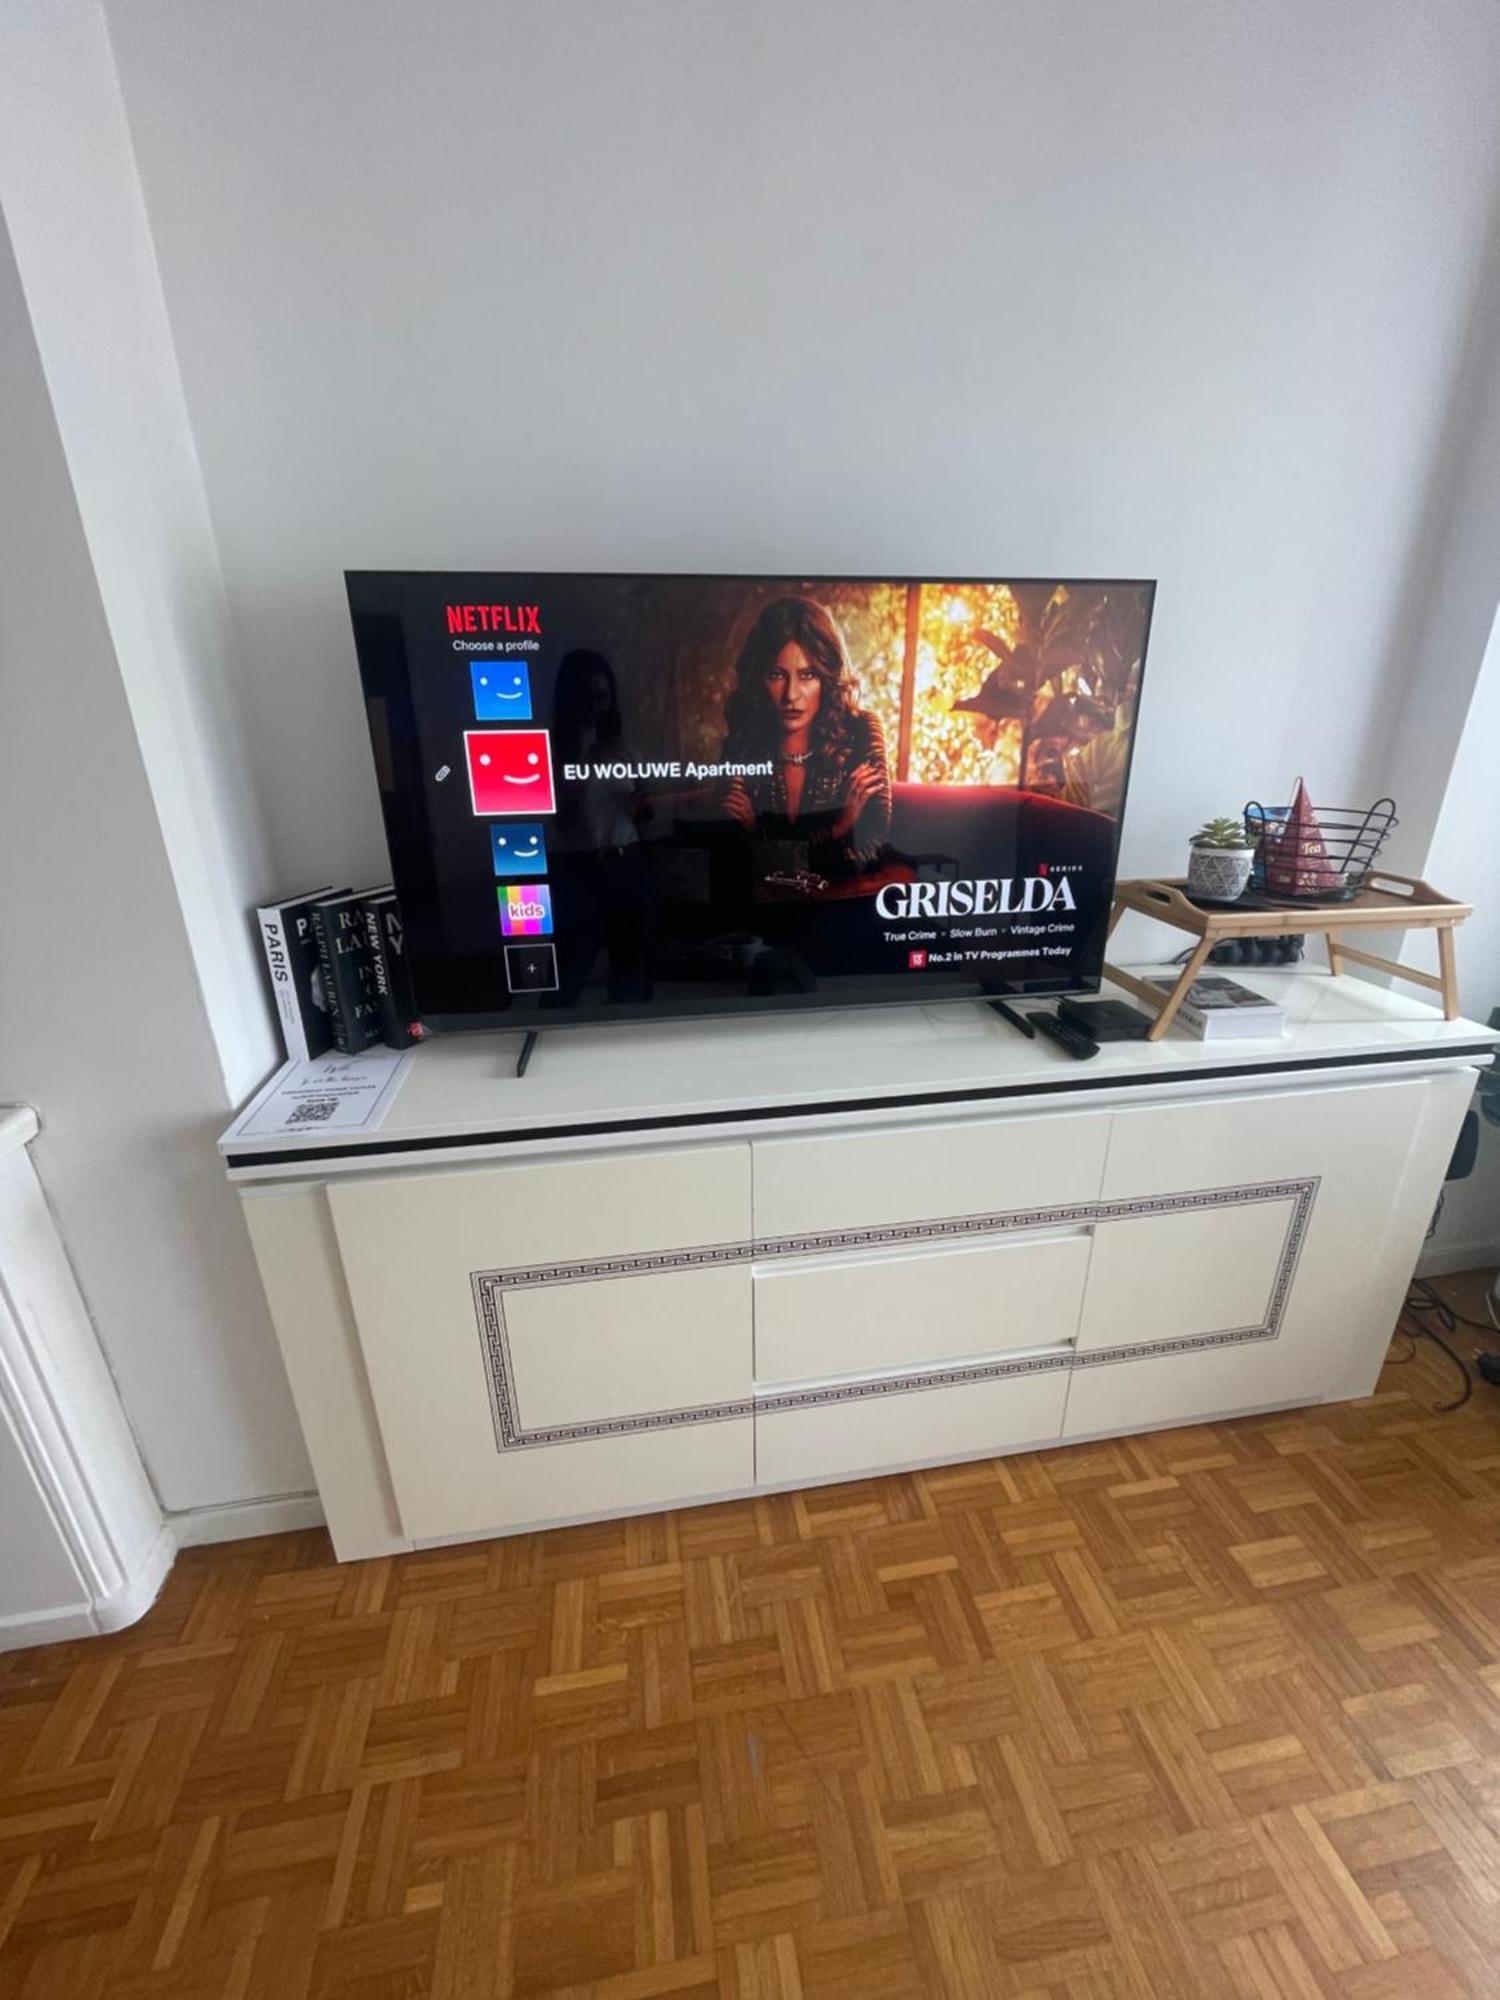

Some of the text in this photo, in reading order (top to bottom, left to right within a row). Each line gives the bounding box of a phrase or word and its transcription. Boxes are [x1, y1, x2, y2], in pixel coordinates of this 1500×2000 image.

[446, 605, 542, 634] NETFLIX
[452, 639, 540, 654] Choose a profile
[564, 760, 774, 780] EU WOLUWE Apartment
[1302, 842, 1321, 854] Tea
[876, 875, 1077, 919] GRISELDA
[510, 904, 544, 918] kids
[883, 923, 1075, 942] True Crime Slow Burn Vintage Crime
[264, 923, 289, 982] PARIS
[365, 912, 389, 995] NEW YORK
[928, 952, 953, 963] No.2
[953, 951, 963, 961] in
[964, 951, 979, 960] TV
[980, 948, 1040, 961] Programmes
[1042, 945, 1072, 957] Today
